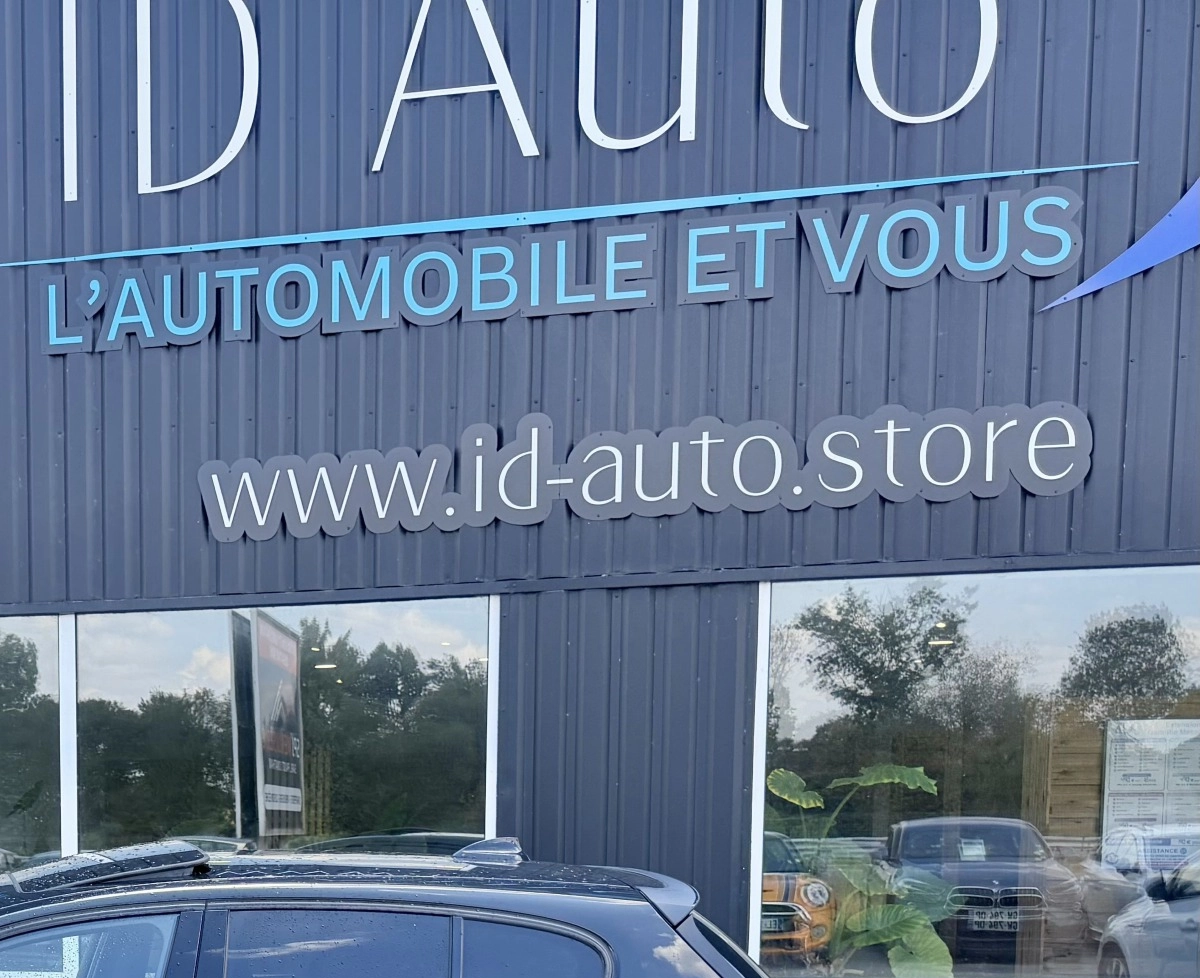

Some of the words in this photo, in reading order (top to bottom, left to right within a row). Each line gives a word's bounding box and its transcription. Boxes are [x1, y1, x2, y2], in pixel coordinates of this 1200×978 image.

[62, 0, 259, 201] ID
[371, 0, 998, 172] Auto
[47, 232, 647, 346] L'AUTOMOBILE
[687, 220, 786, 294] ET
[812, 196, 1072, 283] VOUS
[211, 416, 1077, 527] www.id-auto.store
